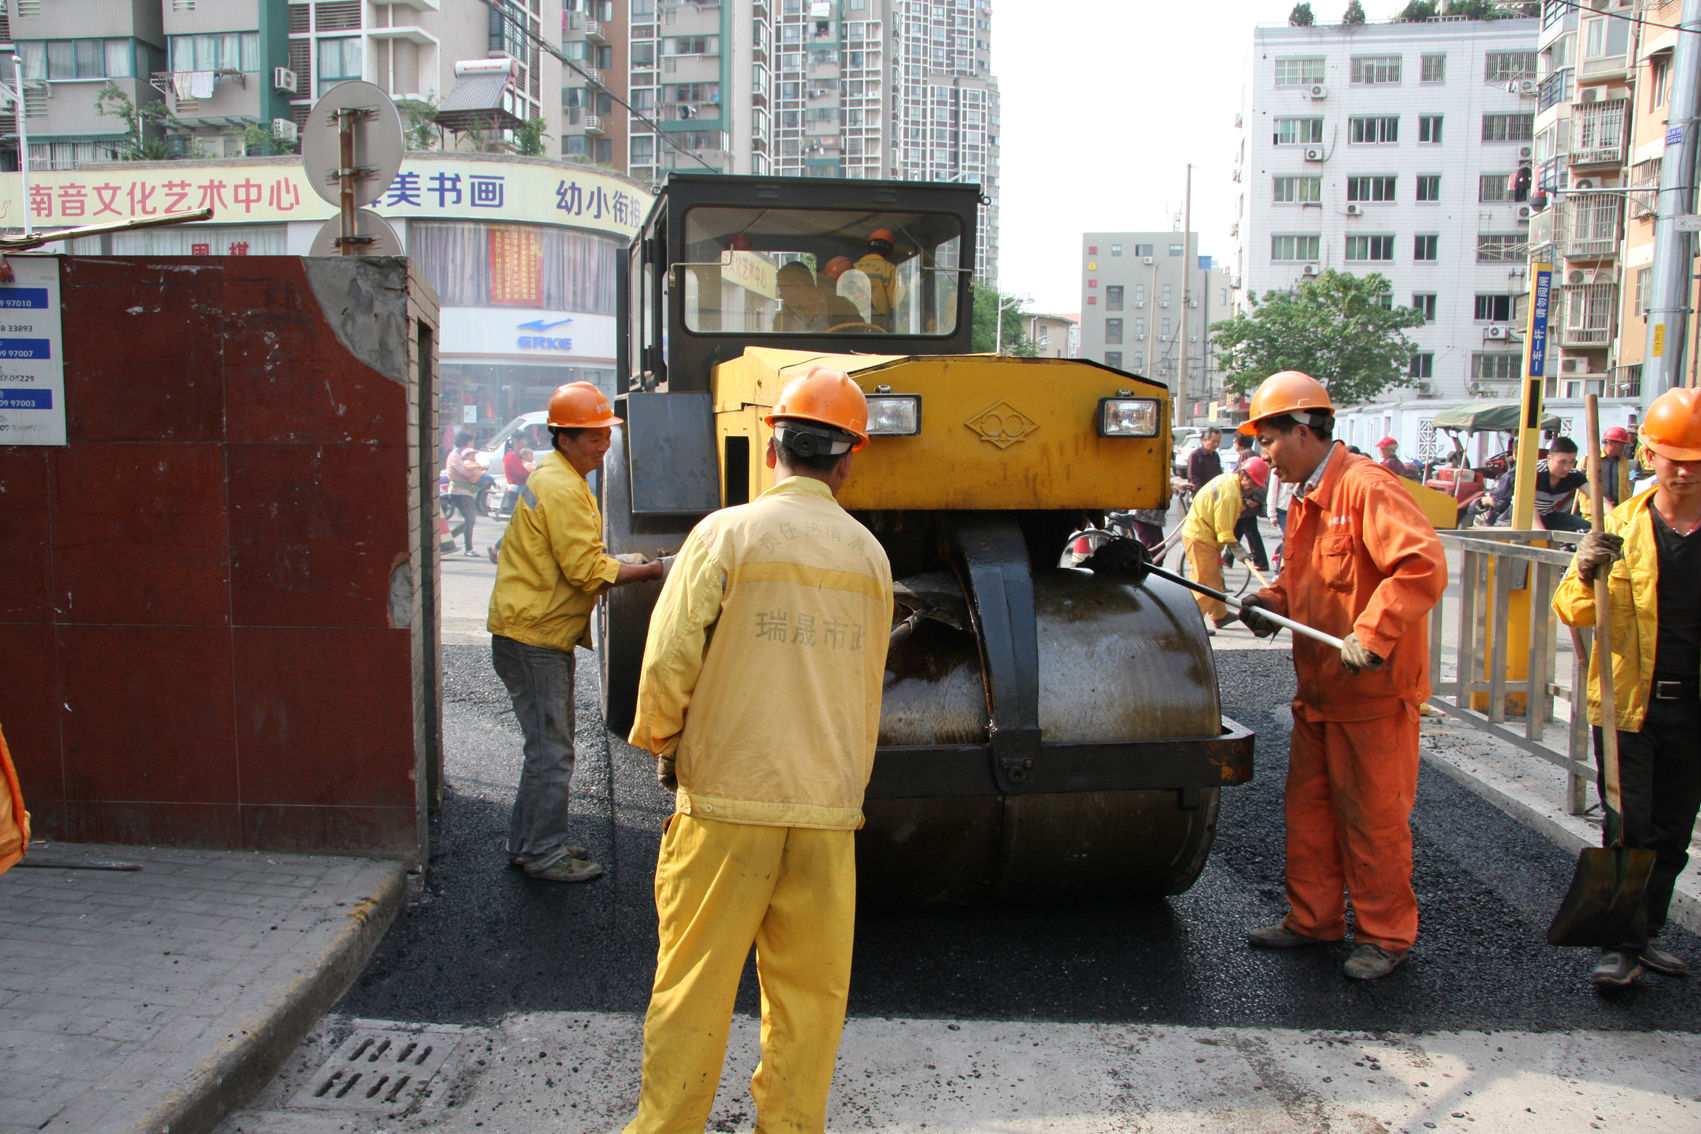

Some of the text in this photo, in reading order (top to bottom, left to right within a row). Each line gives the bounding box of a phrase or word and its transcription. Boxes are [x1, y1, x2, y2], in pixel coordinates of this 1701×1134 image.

[29, 176, 301, 218] 南音文化艺术中心
[371, 171, 641, 229] 美书画 幼小衔接
[6, 300, 32, 308] 97010
[517, 335, 573, 351] ERKE
[8, 350, 34, 358] 97007
